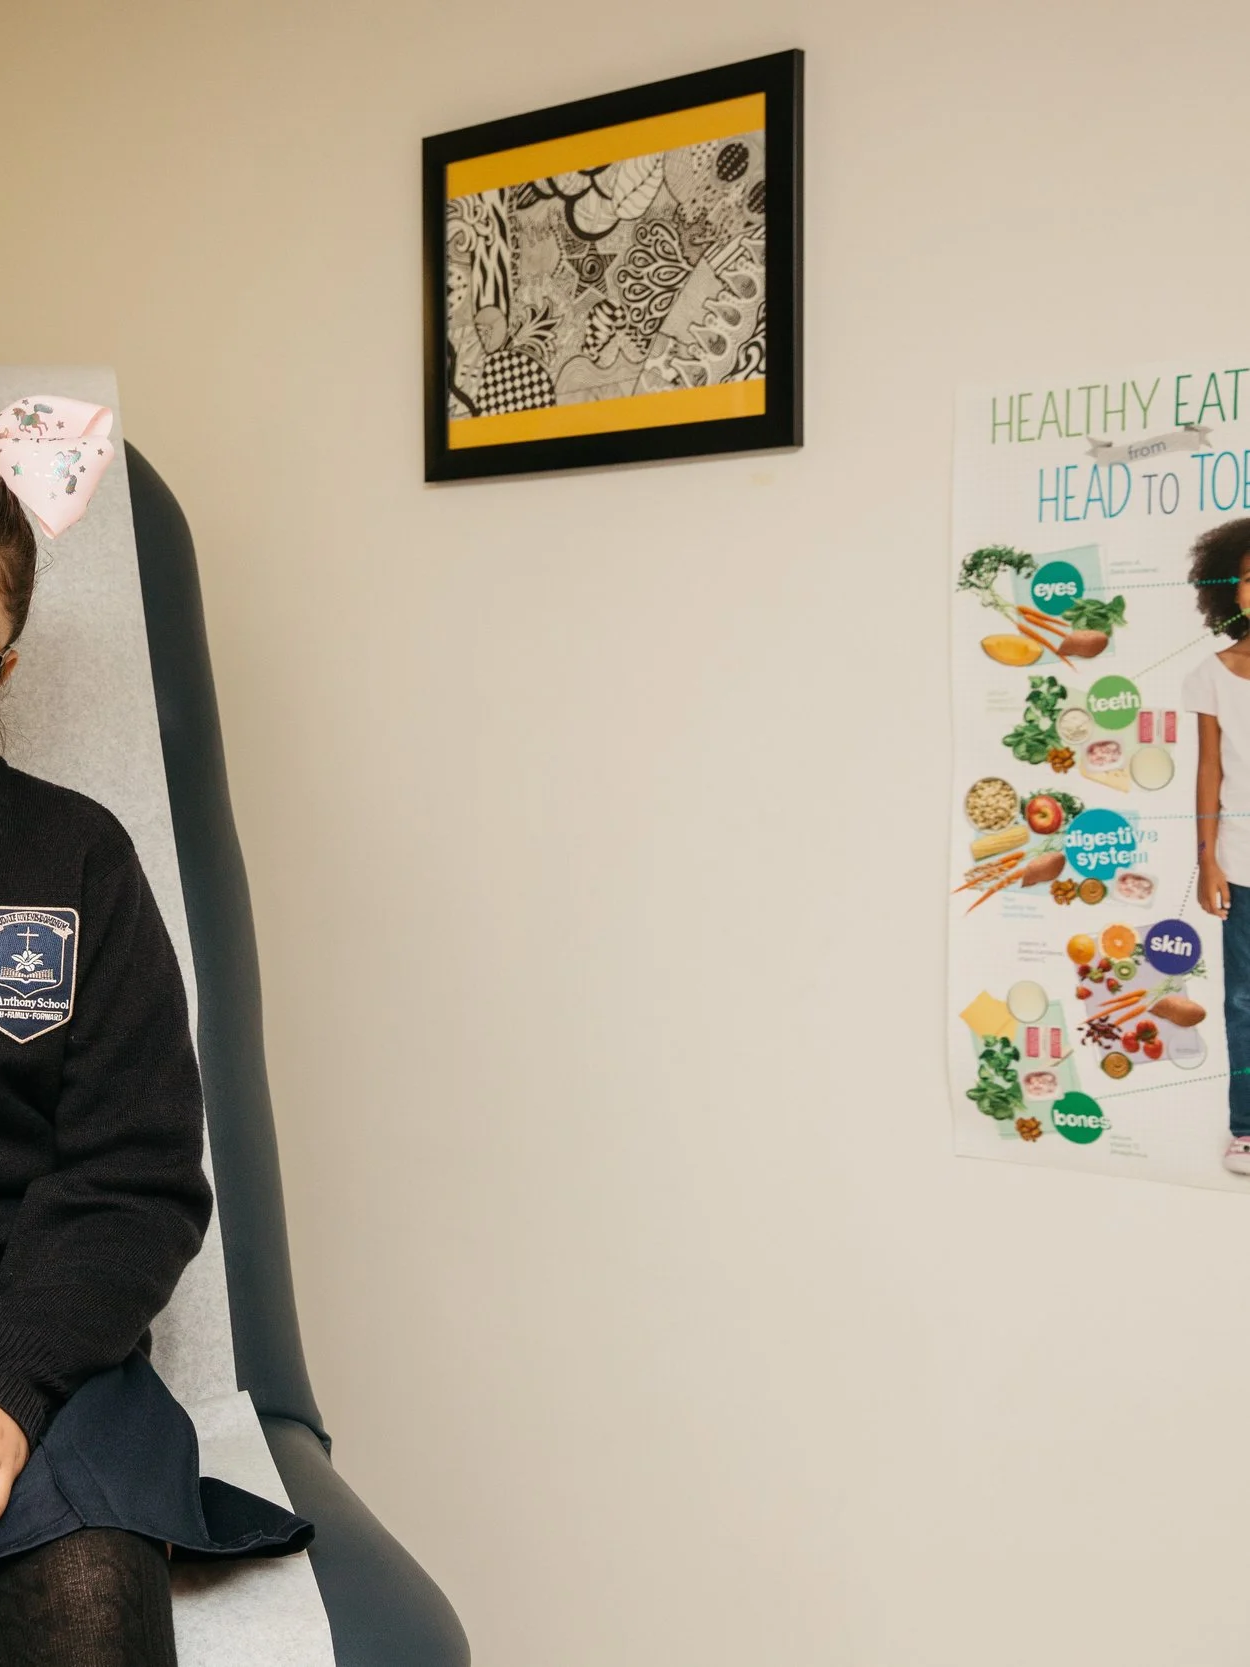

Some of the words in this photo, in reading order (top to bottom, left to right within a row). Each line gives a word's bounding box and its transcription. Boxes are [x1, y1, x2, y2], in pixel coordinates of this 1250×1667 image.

[992, 377, 1160, 444] HEALTHY
[1127, 440, 1167, 460] from
[1038, 462, 1131, 523] HEAD
[1142, 472, 1180, 515] TO
[1034, 580, 1078, 601] eyes
[1088, 691, 1140, 712] teeth
[1065, 826, 1158, 851] digestive
[1076, 846, 1148, 870] system
[1150, 934, 1193, 957] skin
[37, 997, 69, 1009] School
[1054, 1109, 1111, 1130] bones
